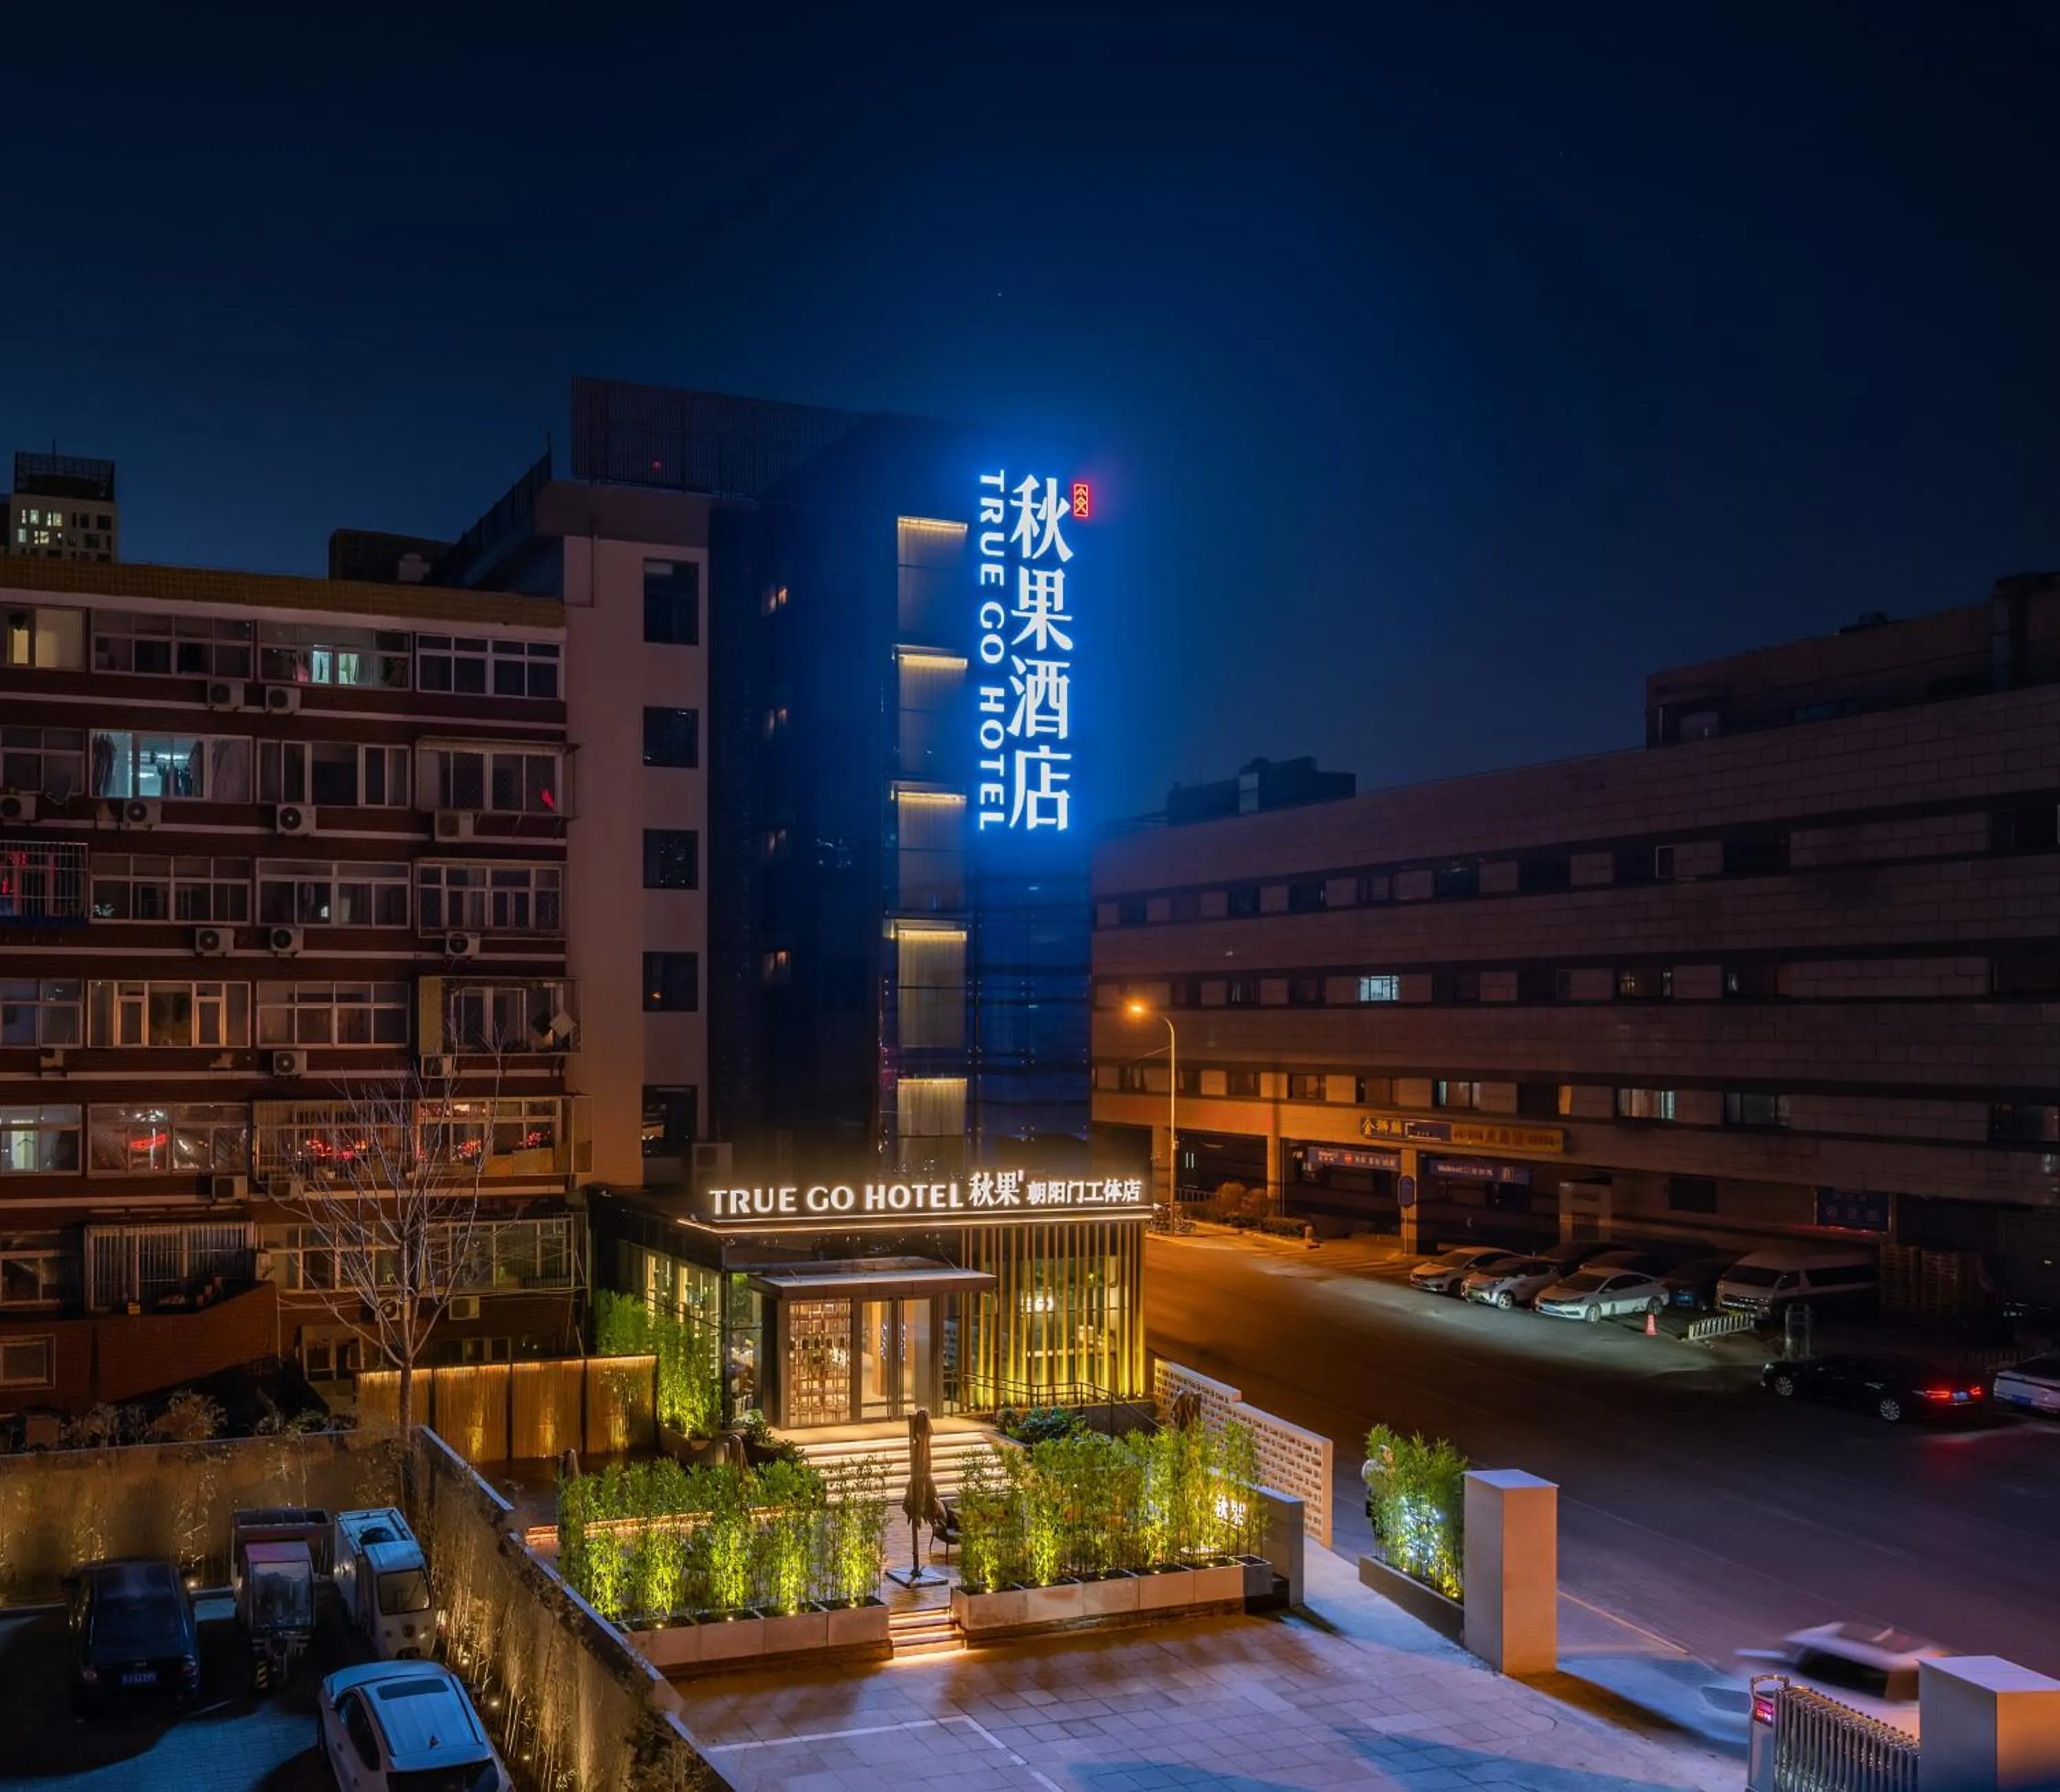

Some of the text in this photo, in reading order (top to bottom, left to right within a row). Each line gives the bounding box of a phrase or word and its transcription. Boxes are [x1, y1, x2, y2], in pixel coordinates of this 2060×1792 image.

[980, 469, 1005, 831] TRUE GO HOTEL
[1006, 474, 1074, 831] 秋果酒店
[708, 1182, 964, 1215] TRUE GO HOTEL
[968, 1171, 1143, 1207] 秋果 朝阳门工体店
